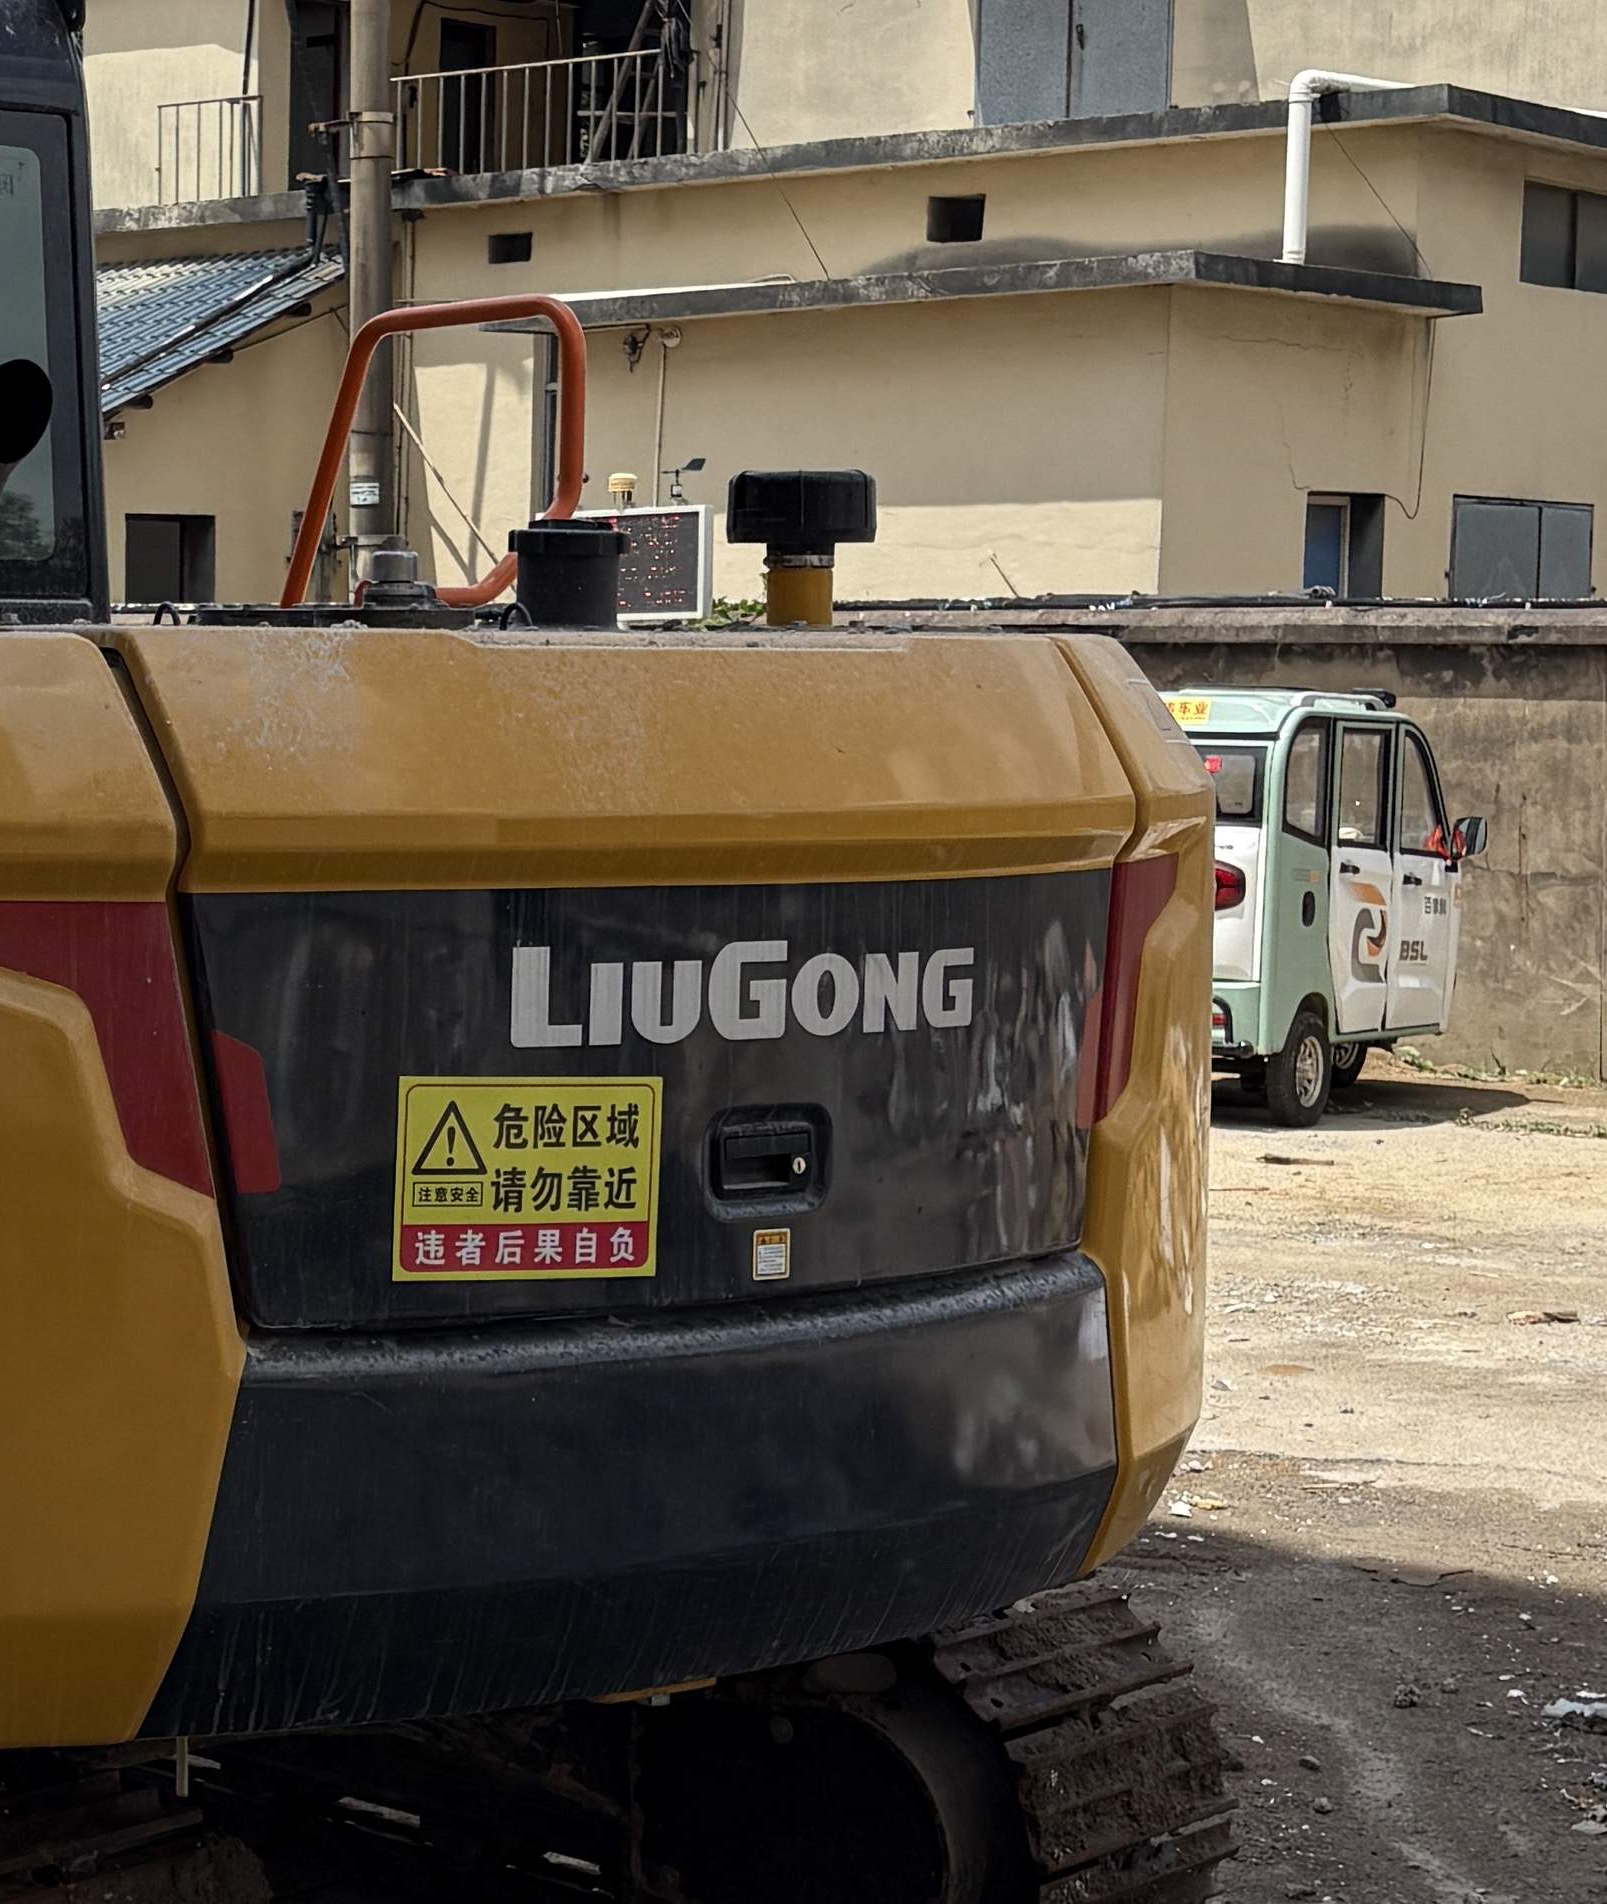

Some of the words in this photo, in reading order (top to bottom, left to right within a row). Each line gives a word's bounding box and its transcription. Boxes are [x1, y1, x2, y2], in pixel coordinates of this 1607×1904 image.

[1399, 940, 1428, 961] BSL
[493, 1103, 640, 1149] 危险区域
[418, 1187, 479, 1203] 注意安全
[491, 1166, 638, 1212] 请勿靠近
[415, 1227, 635, 1266] 违者后果自负
